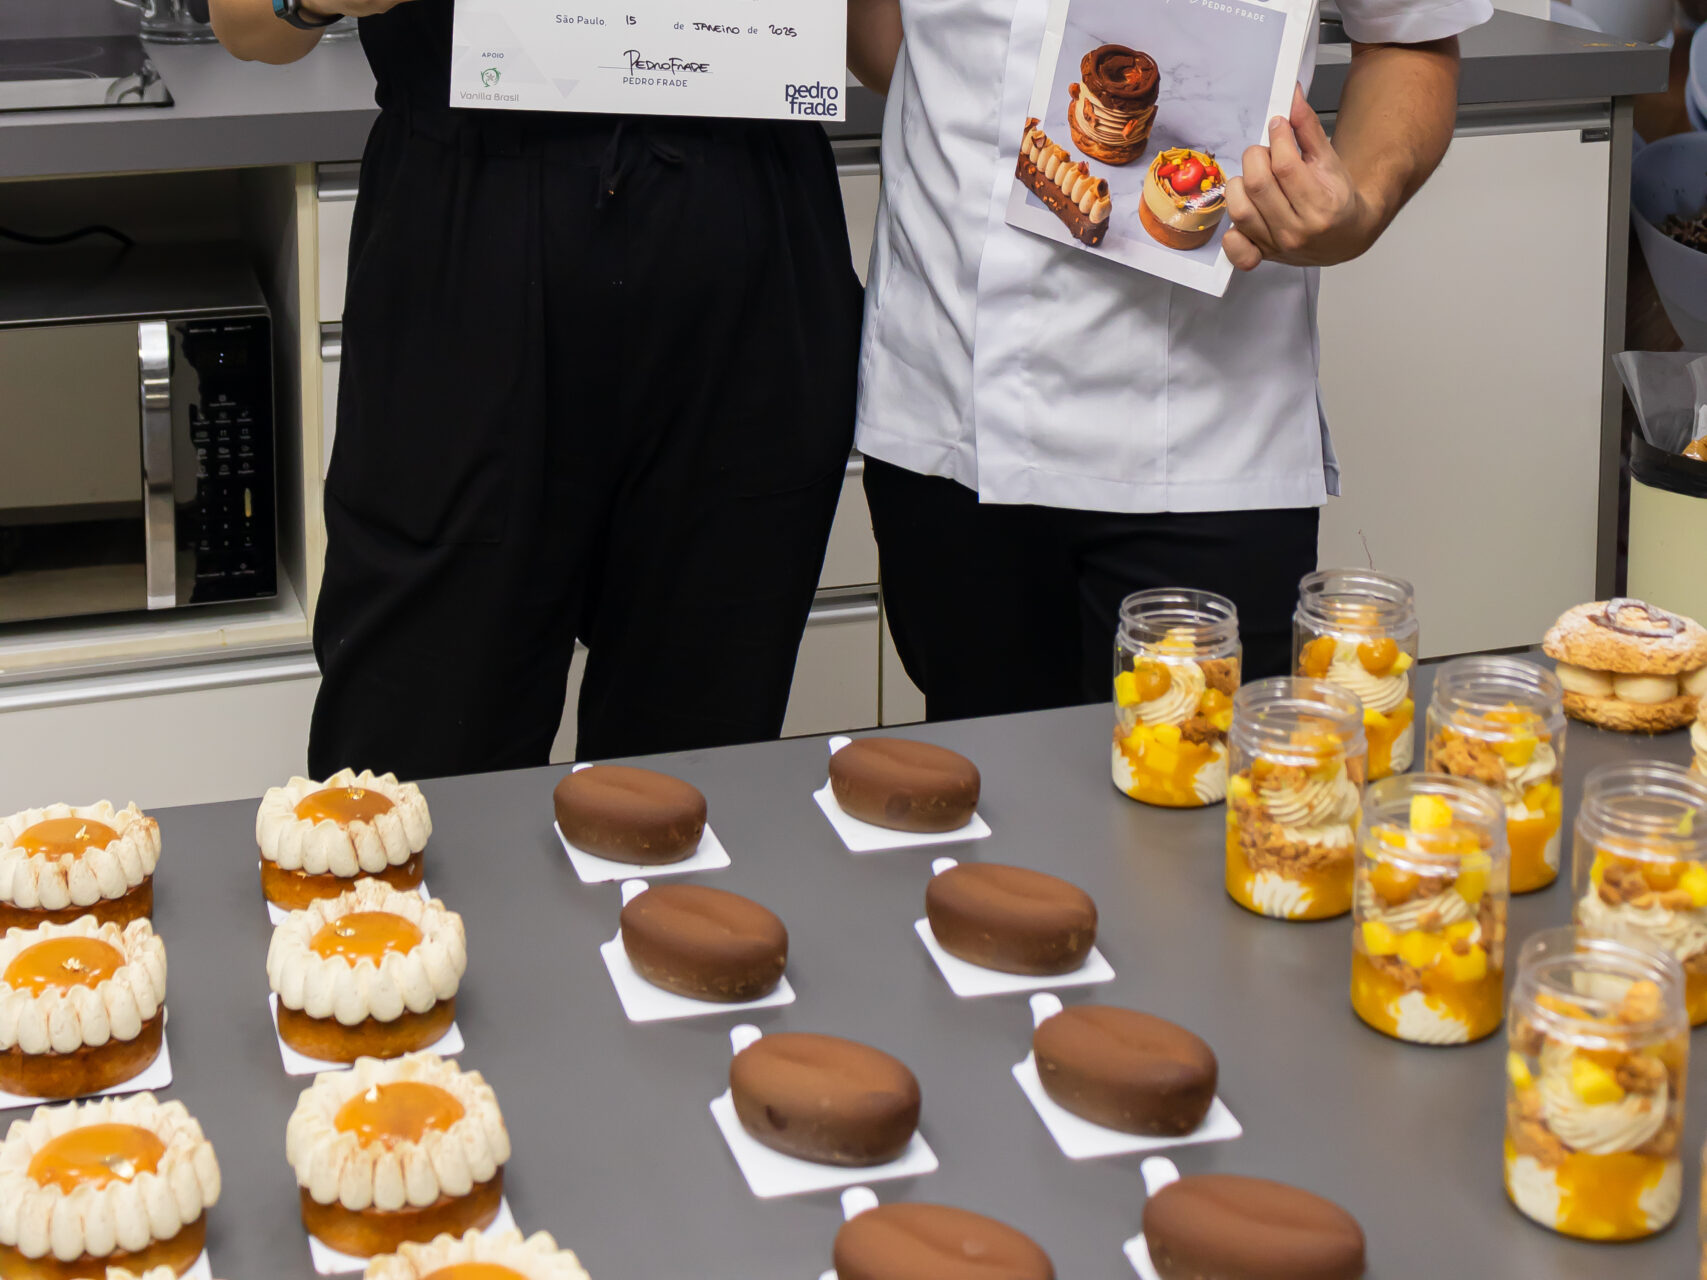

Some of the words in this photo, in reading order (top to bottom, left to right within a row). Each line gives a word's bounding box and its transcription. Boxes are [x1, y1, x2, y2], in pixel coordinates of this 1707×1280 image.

[1201, 0, 1233, 14] PEDRO
[555, 14, 575, 25] São
[625, 14, 637, 26] 15
[673, 21, 685, 31] de
[747, 25, 758, 35] de
[768, 24, 798, 38] 2025
[481, 52, 505, 60] APOIO
[622, 76, 655, 86] PEDRO
[656, 78, 688, 88] FRADE
[459, 90, 492, 102] Vanilla
[494, 93, 520, 103] Brasil
[785, 81, 839, 102] pedro
[789, 96, 838, 117] frade
